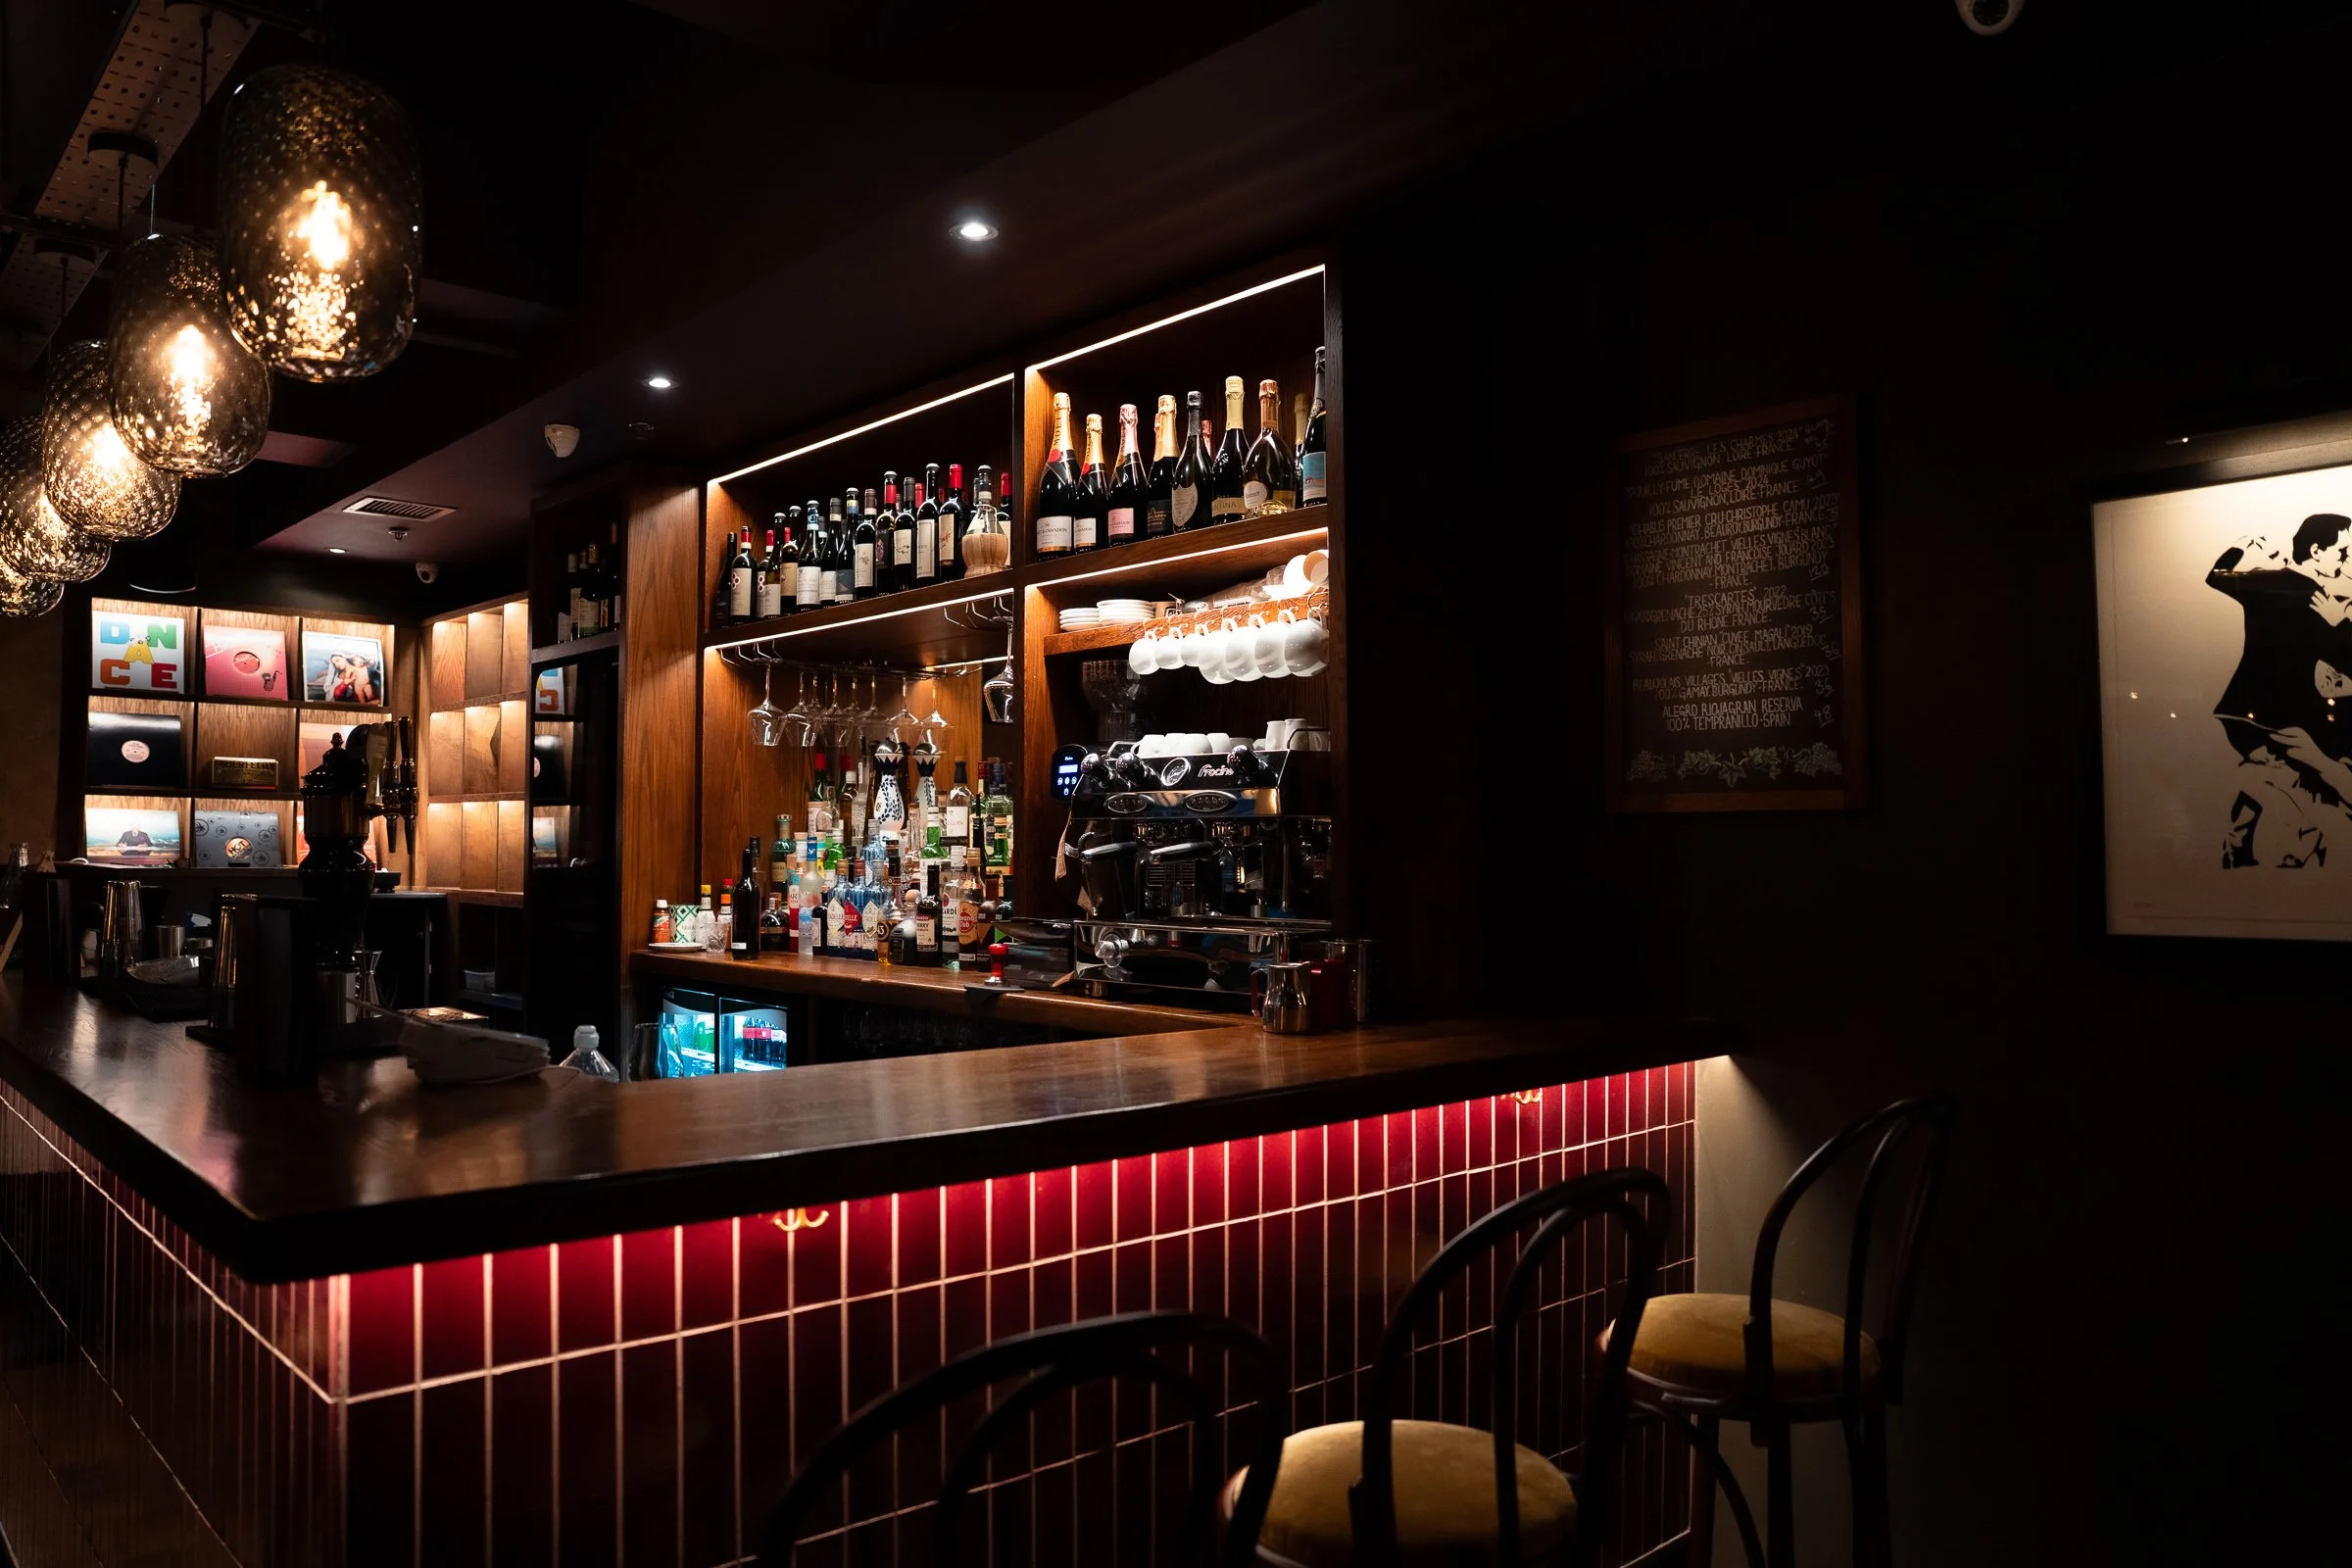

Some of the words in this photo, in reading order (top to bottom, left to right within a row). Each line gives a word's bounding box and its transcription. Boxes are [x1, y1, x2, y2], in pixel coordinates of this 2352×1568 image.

[1707, 441, 1727, 455] LES
[1666, 454, 1720, 473] SAUVIGNON
[1693, 469, 1737, 488] DOMAINE
[1740, 459, 1788, 479] DOMINIQUE
[1791, 453, 1830, 470] GUYOT
[1667, 514, 1702, 534] PREMIER
[1706, 553, 1723, 565] AND
[1778, 550, 1829, 571] BURGUNDY
[1680, 618, 1694, 633] DU
[1654, 636, 1682, 652] SAINT
[1685, 673, 1725, 687] VILLAGES
[1662, 704, 1698, 718] ALEGRO
[1761, 696, 1803, 713] RESERVA
[1666, 716, 1690, 731] 100%
